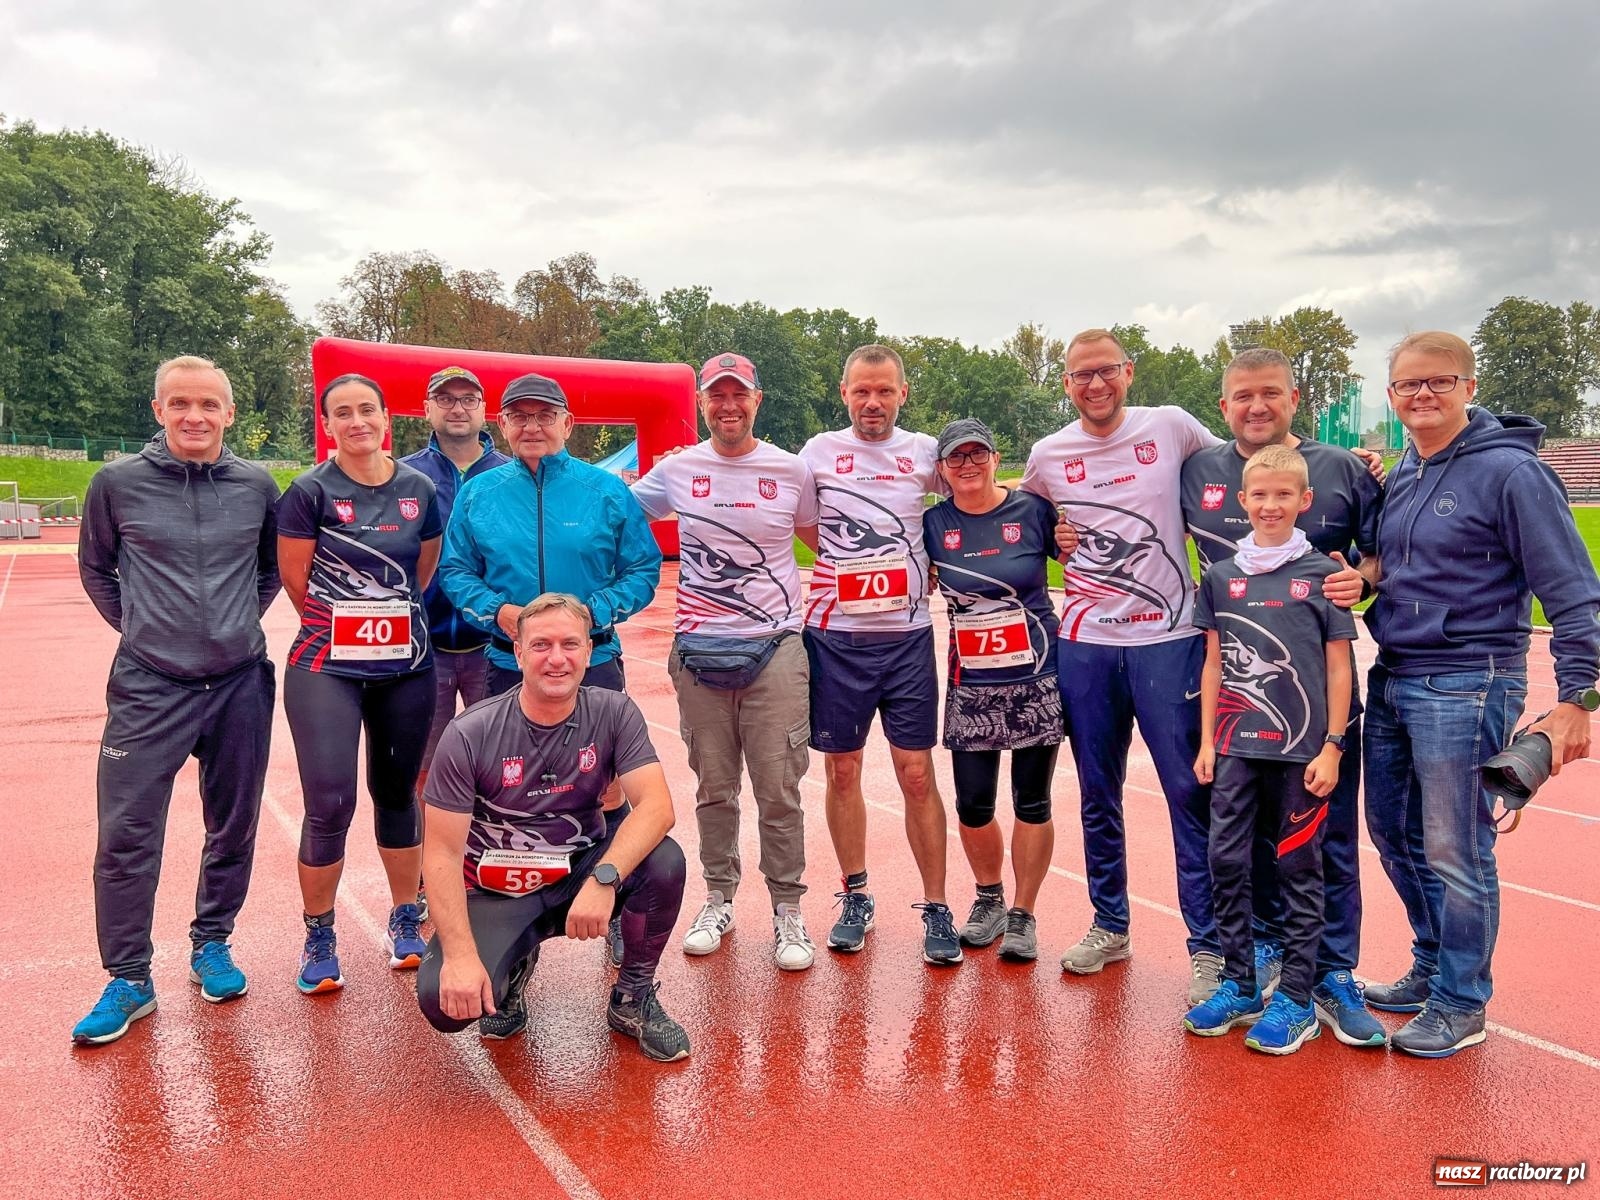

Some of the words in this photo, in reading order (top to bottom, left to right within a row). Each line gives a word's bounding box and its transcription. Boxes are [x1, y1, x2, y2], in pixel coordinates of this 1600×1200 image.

[856, 573, 889, 598] 70
[355, 618, 393, 644] 40
[974, 629, 1007, 654] 75
[504, 869, 542, 891] 58
